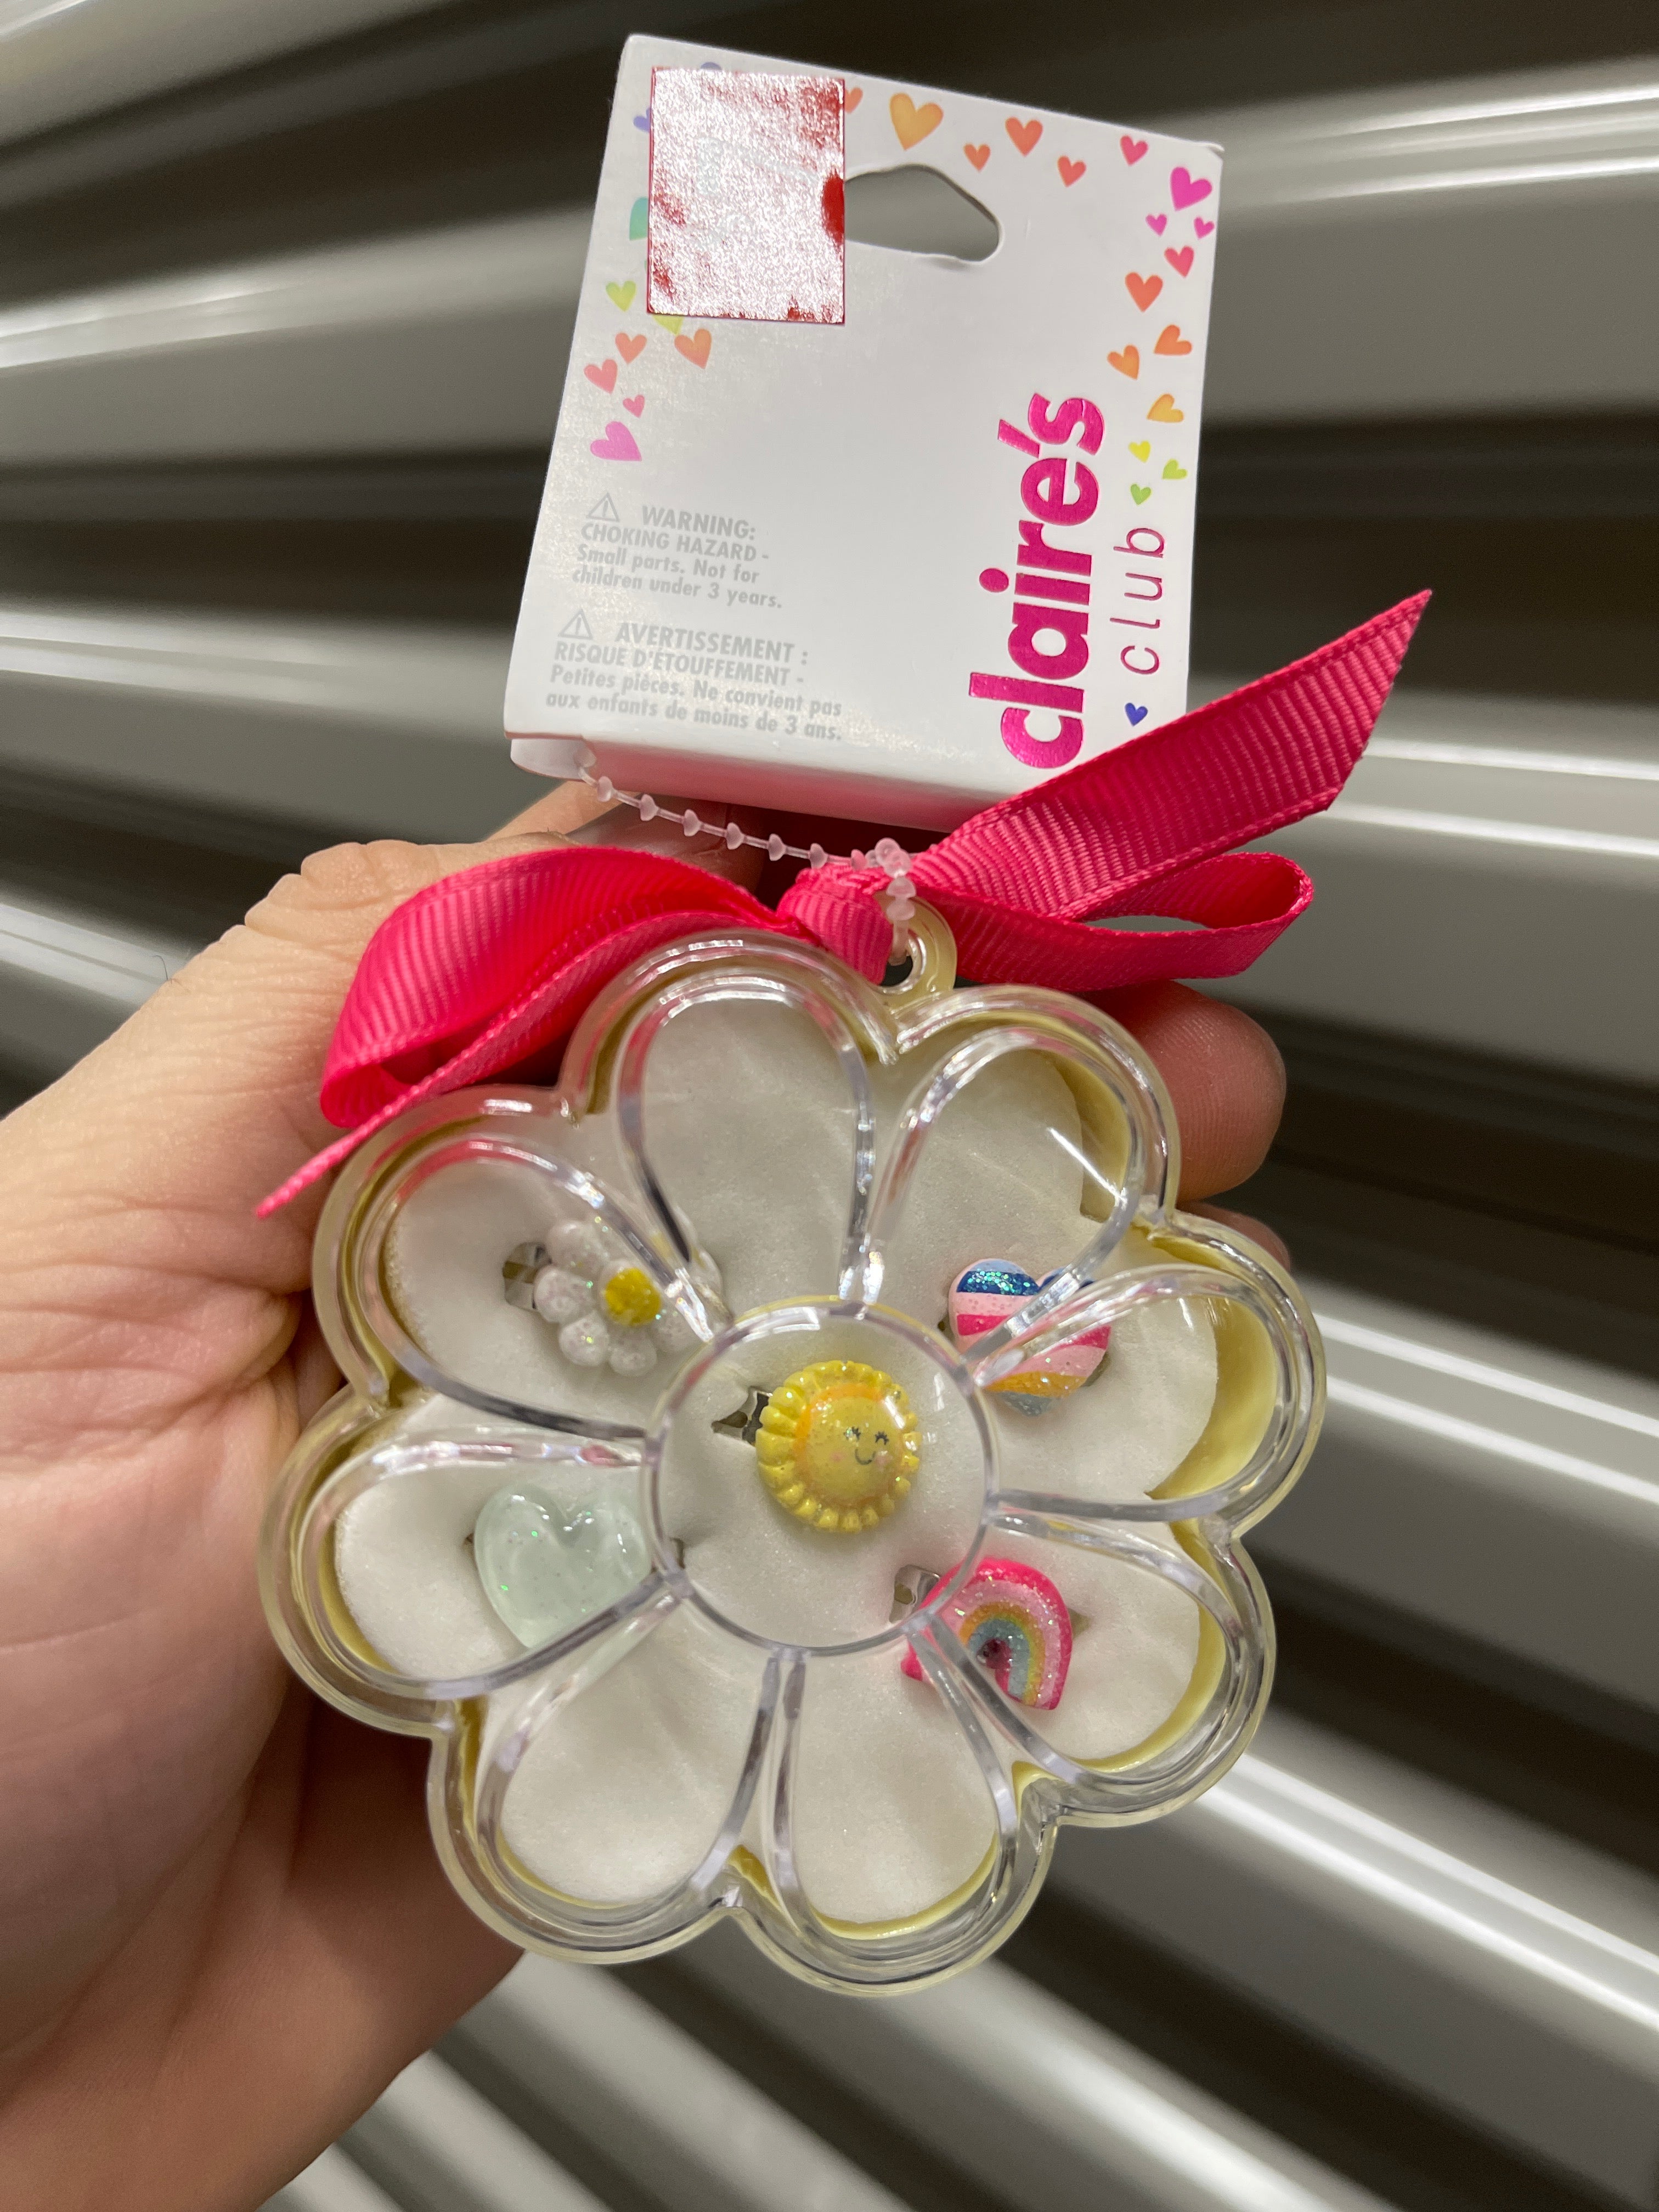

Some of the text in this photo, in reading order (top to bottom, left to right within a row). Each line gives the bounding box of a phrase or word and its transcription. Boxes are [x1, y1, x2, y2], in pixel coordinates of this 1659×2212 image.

[581, 522, 670, 550] CHOKING
[676, 534, 757, 562] HAZARD
[642, 505, 756, 540] WARNING:
[577, 543, 760, 583] Small parts. Not for
[969, 393, 1104, 768] claire's
[572, 565, 782, 608] children under 3 years.
[1110, 528, 1165, 675] club
[555, 641, 628, 667] RISQUE
[633, 647, 791, 686] D'ÉTOUFFEMENT
[614, 623, 795, 663] AVERTISSEMENT
[550, 664, 842, 719] Petites pièces. Ne convient pas
[546, 692, 842, 741] aux enfants de moins de 3 ans.
